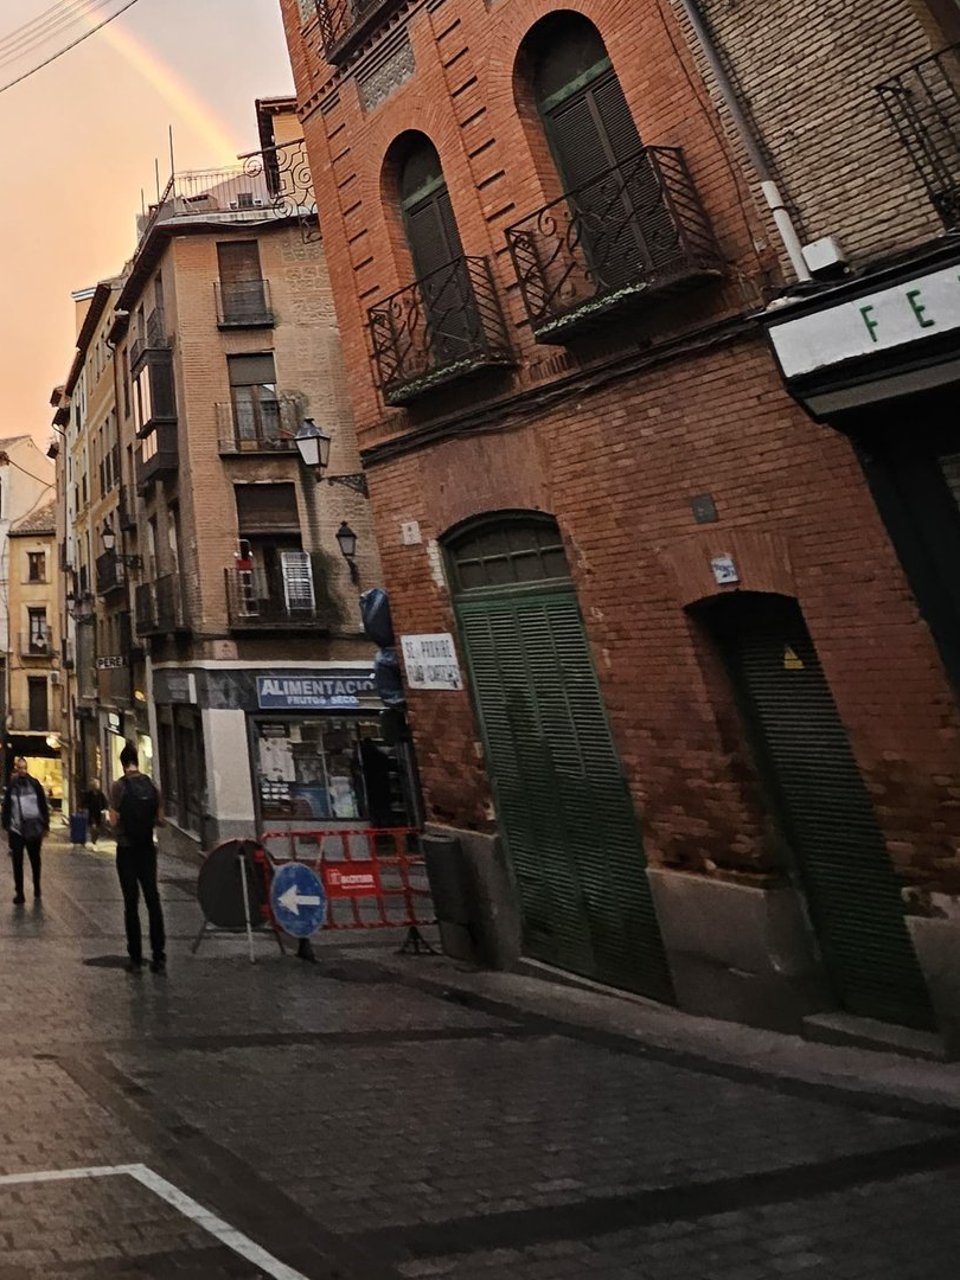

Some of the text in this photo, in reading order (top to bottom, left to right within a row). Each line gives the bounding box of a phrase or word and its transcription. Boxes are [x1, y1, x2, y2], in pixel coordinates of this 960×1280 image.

[860, 275, 960, 342] FE
[261, 679, 375, 696] ALIMENTACIO
[330, 695, 359, 704] SECO
